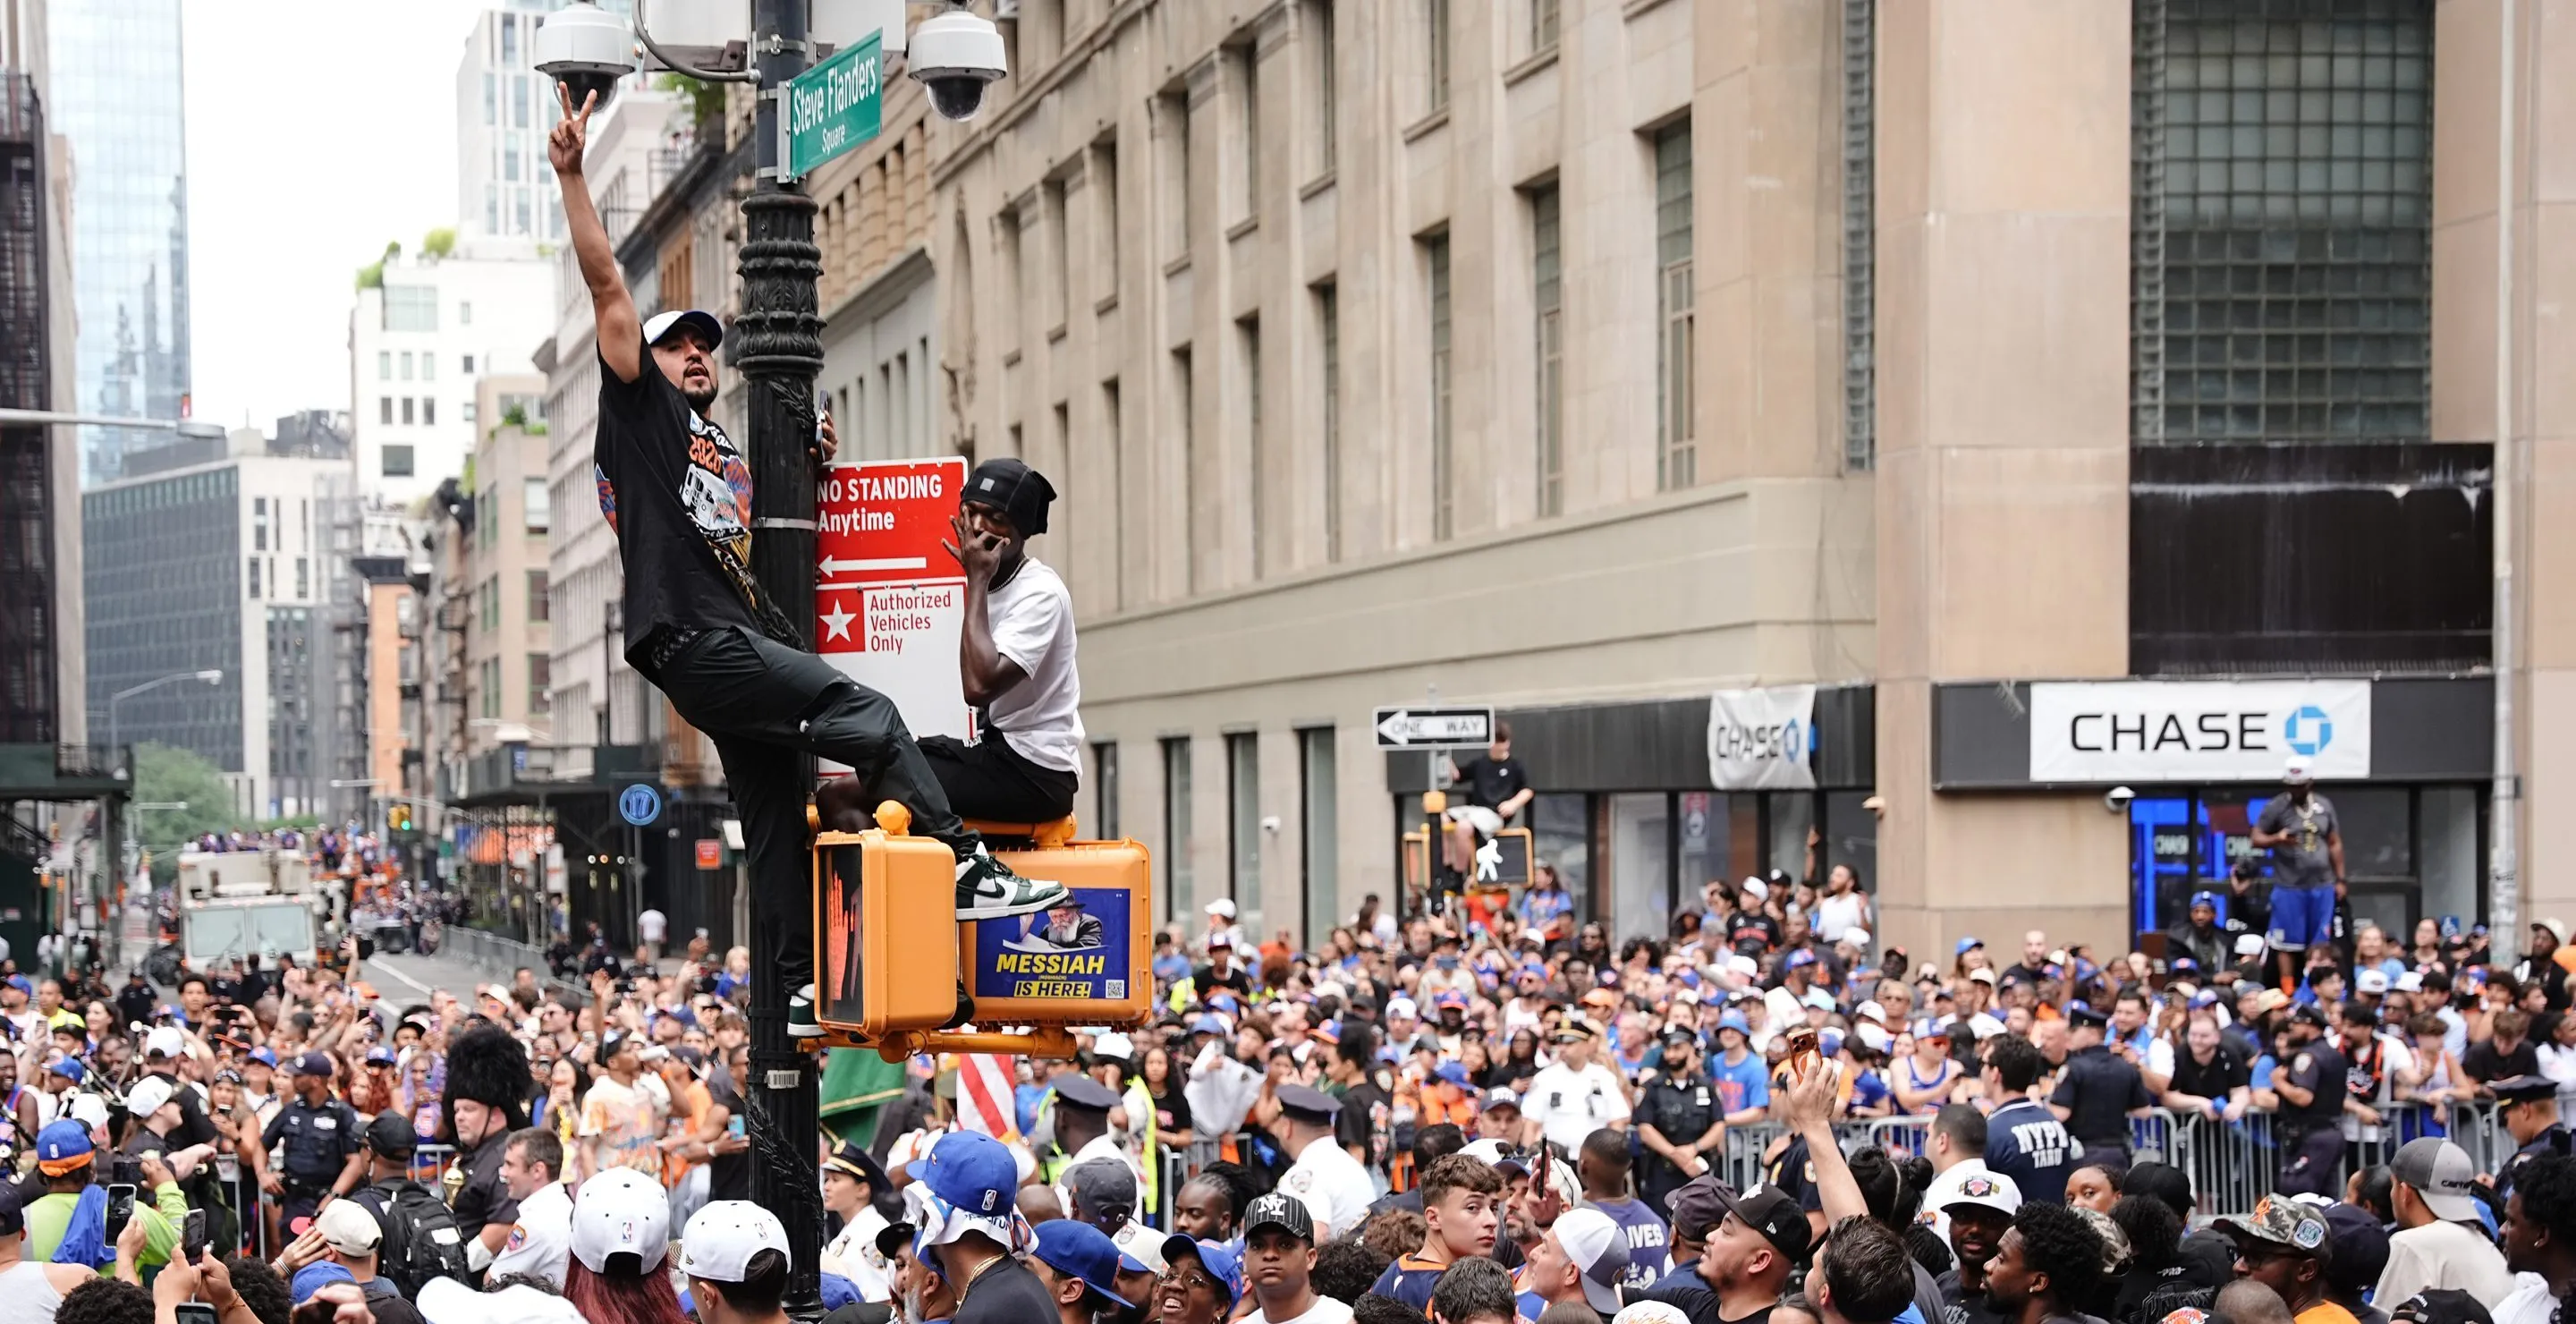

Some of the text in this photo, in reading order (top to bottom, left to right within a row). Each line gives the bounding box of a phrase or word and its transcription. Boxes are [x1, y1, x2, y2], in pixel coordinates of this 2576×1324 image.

[792, 53, 876, 137] Steve Flanders
[822, 123, 845, 156] Square
[817, 474, 943, 503] NO STANDING
[818, 507, 895, 537] Anytime
[870, 591, 951, 611] Authorized
[870, 615, 931, 632] Vehicles
[871, 635, 902, 655] Only
[1390, 717, 1484, 737] ONE WAY
[2071, 714, 2268, 751] CHASE
[1716, 726, 1781, 760] CHASE
[996, 954, 1106, 974] MESSIAH
[1016, 982, 1089, 997] IS HERE!
[1258, 1194, 1287, 1216] NY
[1626, 1223, 1665, 1249] IVES
